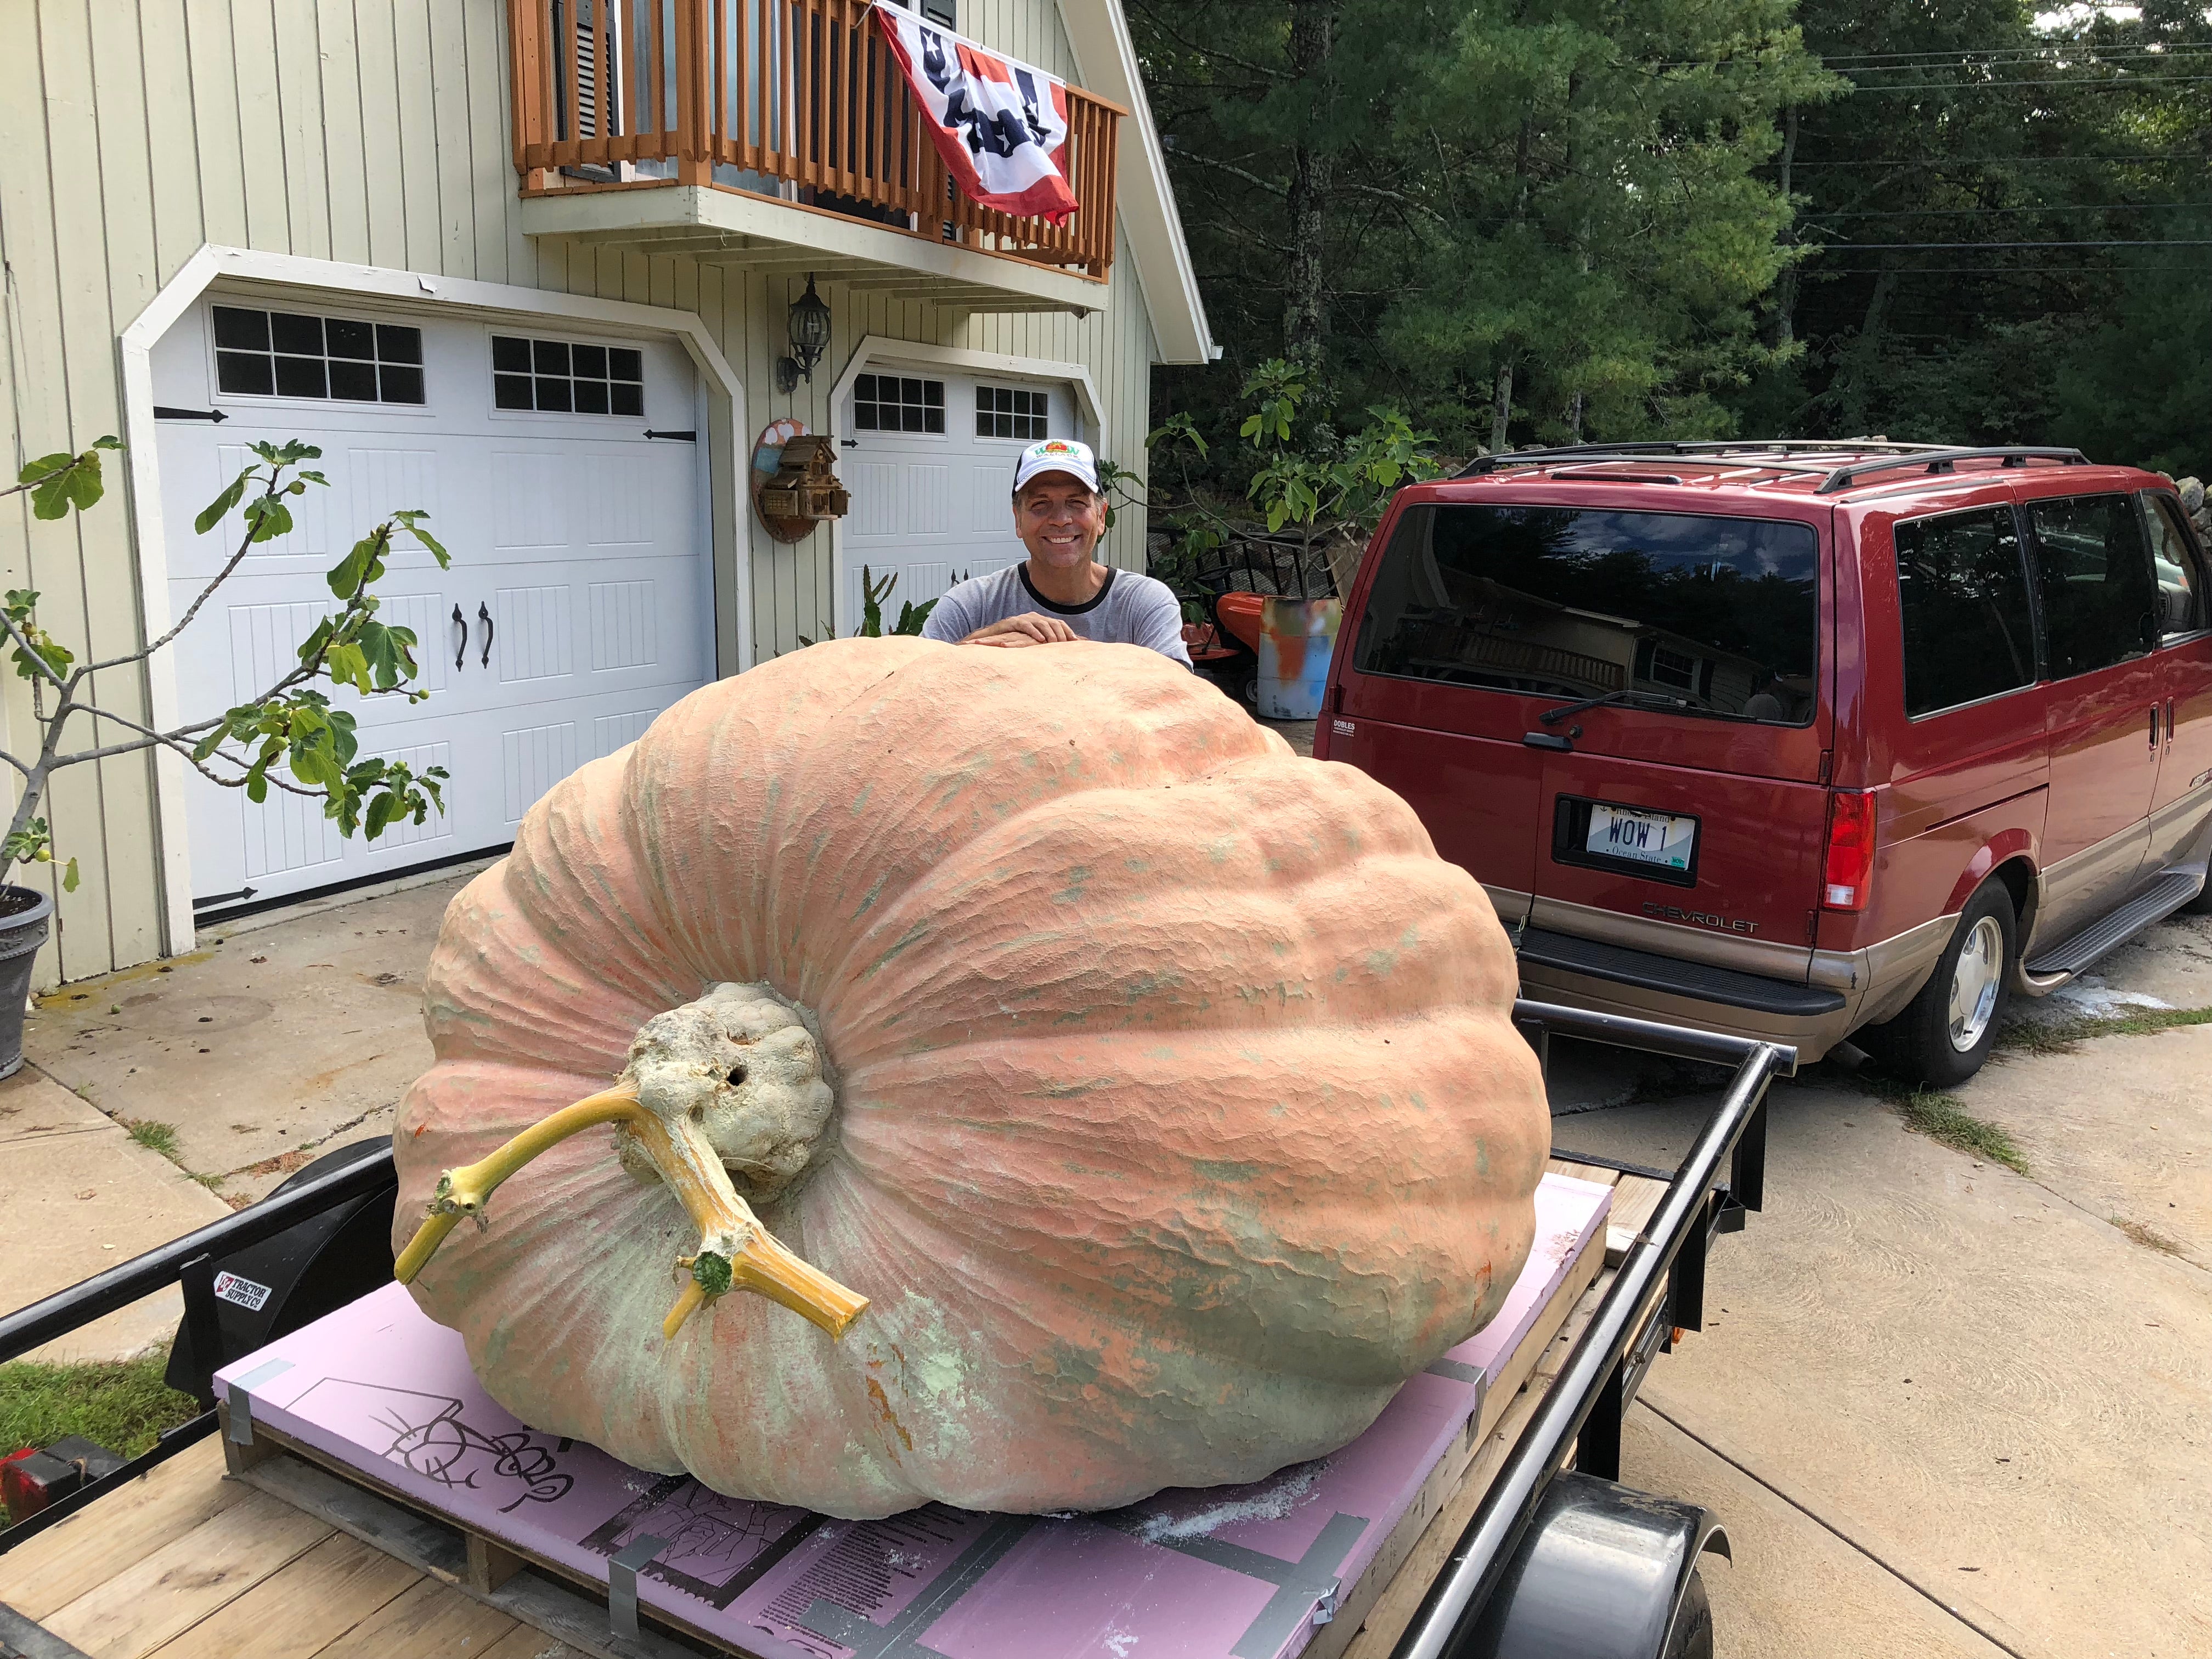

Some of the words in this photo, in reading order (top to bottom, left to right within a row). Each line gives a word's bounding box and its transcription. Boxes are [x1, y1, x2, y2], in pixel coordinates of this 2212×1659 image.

[1334, 719, 1355, 730] DOBLES
[1609, 817, 1650, 848] WOW
[1661, 826, 1667, 851] 1
[1612, 845, 1638, 860] Ocean
[1639, 851, 1662, 864] State
[1643, 901, 1759, 933] CHEVROLET
[225, 1288, 252, 1305] SUPPLY
[232, 1278, 267, 1299] TRACTOR
